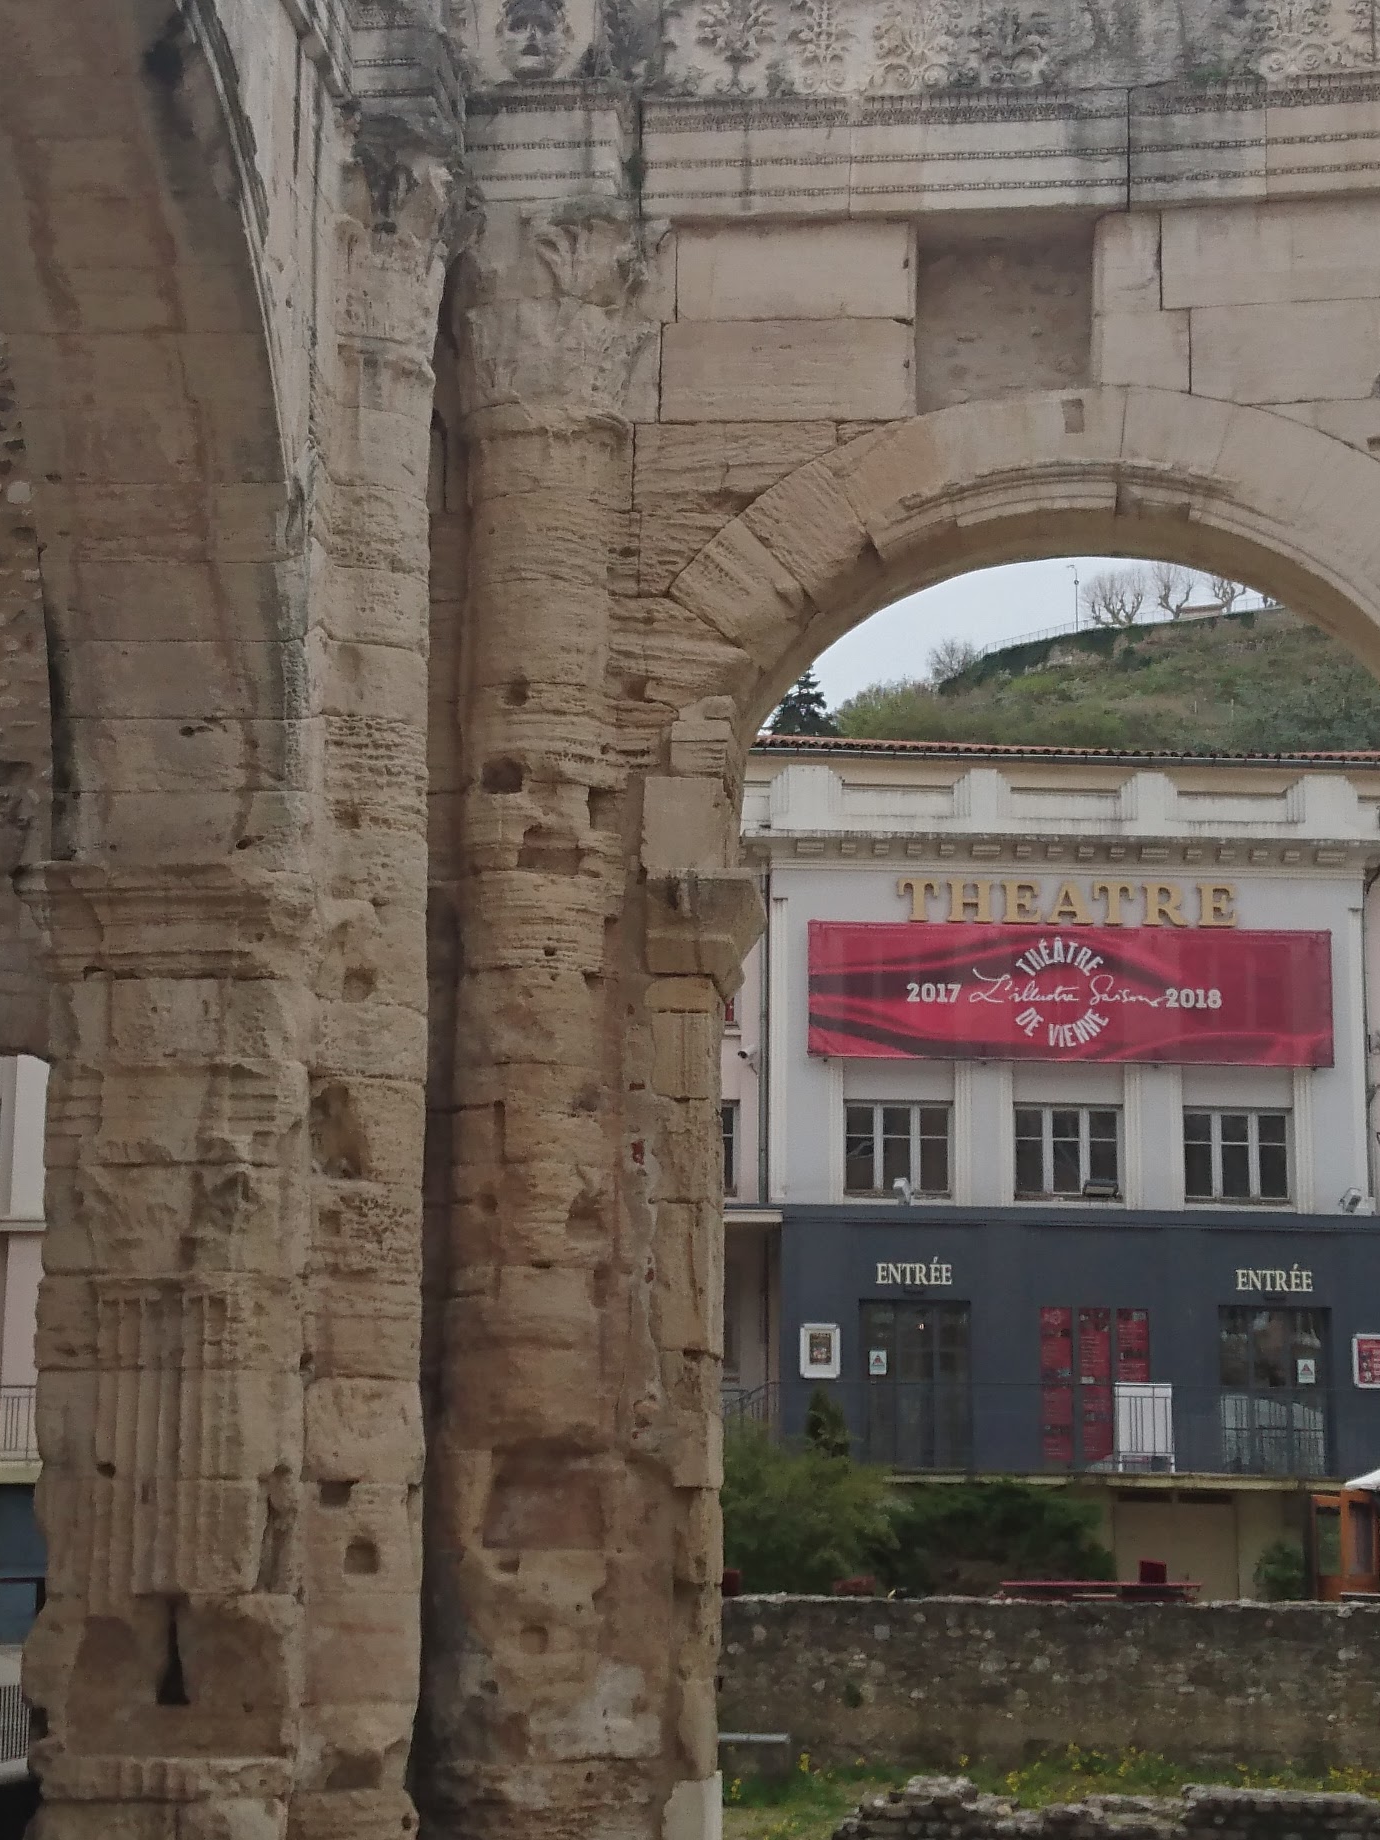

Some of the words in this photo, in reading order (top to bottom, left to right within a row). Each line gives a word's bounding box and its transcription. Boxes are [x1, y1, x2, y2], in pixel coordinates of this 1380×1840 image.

[897, 877, 1238, 929] THEATRE
[1015, 937, 1104, 977] THÉÂTRE
[906, 982, 962, 1004] 2017
[1165, 988, 1223, 1009] 2018
[1015, 1007, 1045, 1038] DE
[1047, 1009, 1110, 1048] VIENNE
[875, 1256, 953, 1285] ENTRÉE
[1235, 1263, 1313, 1292] ENTRÉE
